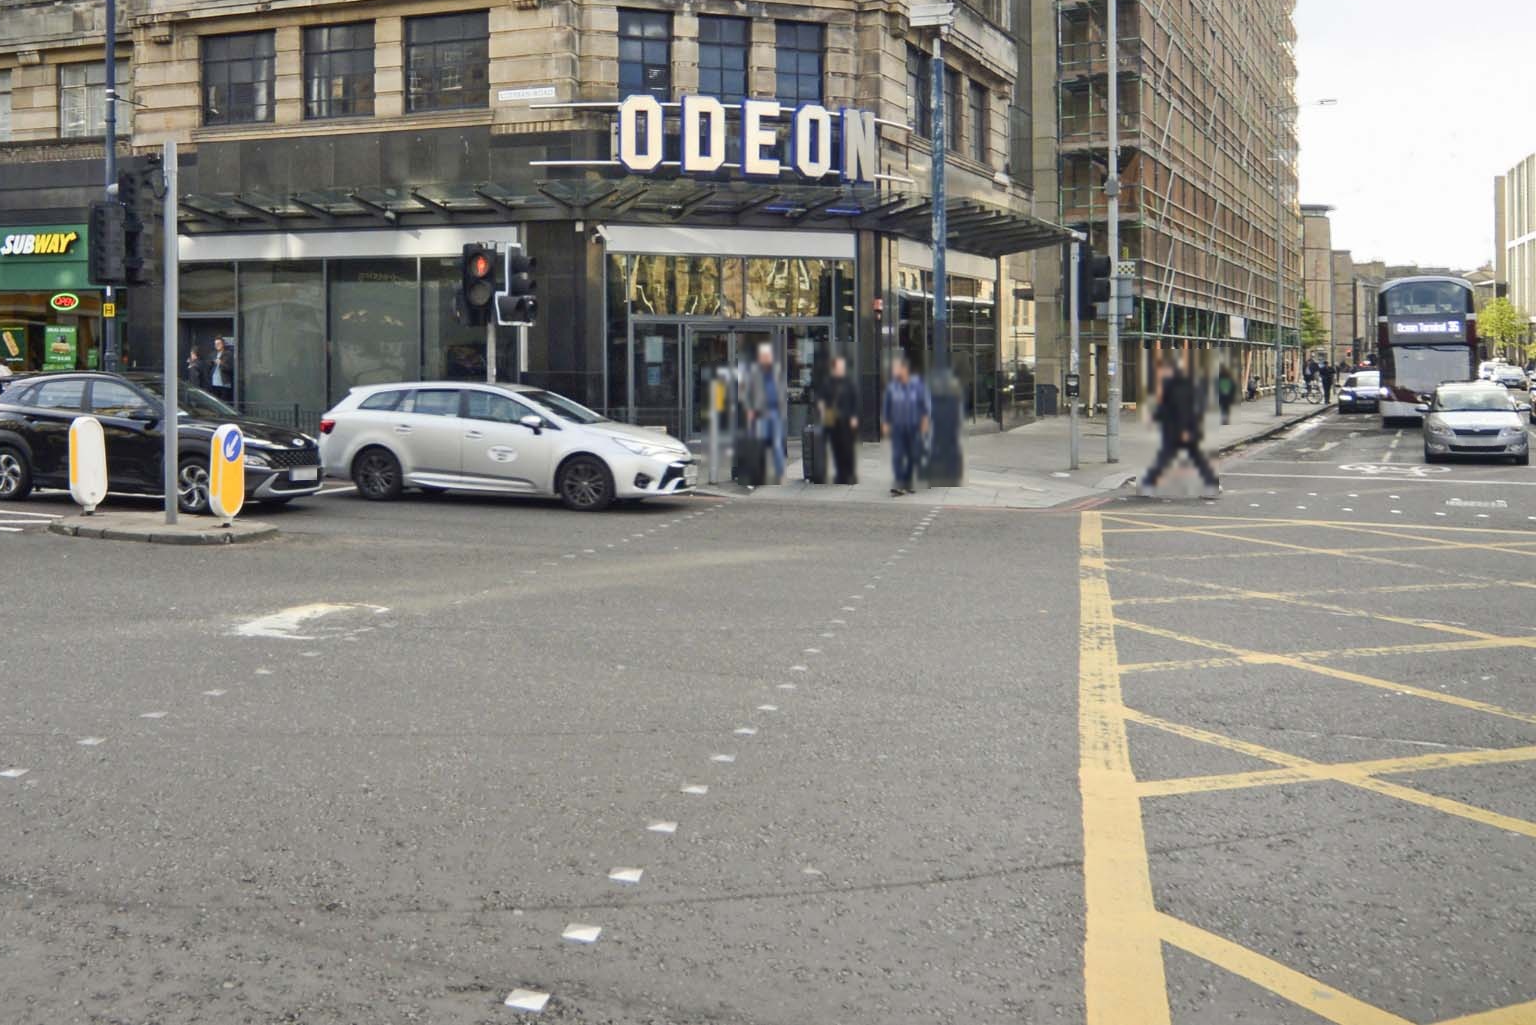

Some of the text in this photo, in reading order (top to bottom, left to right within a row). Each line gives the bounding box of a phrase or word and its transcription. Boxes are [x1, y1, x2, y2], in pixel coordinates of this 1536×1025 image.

[618, 94, 875, 182] ODEON
[0, 232, 77, 256] SUBWAY
[54, 297, 75, 306] OPEN
